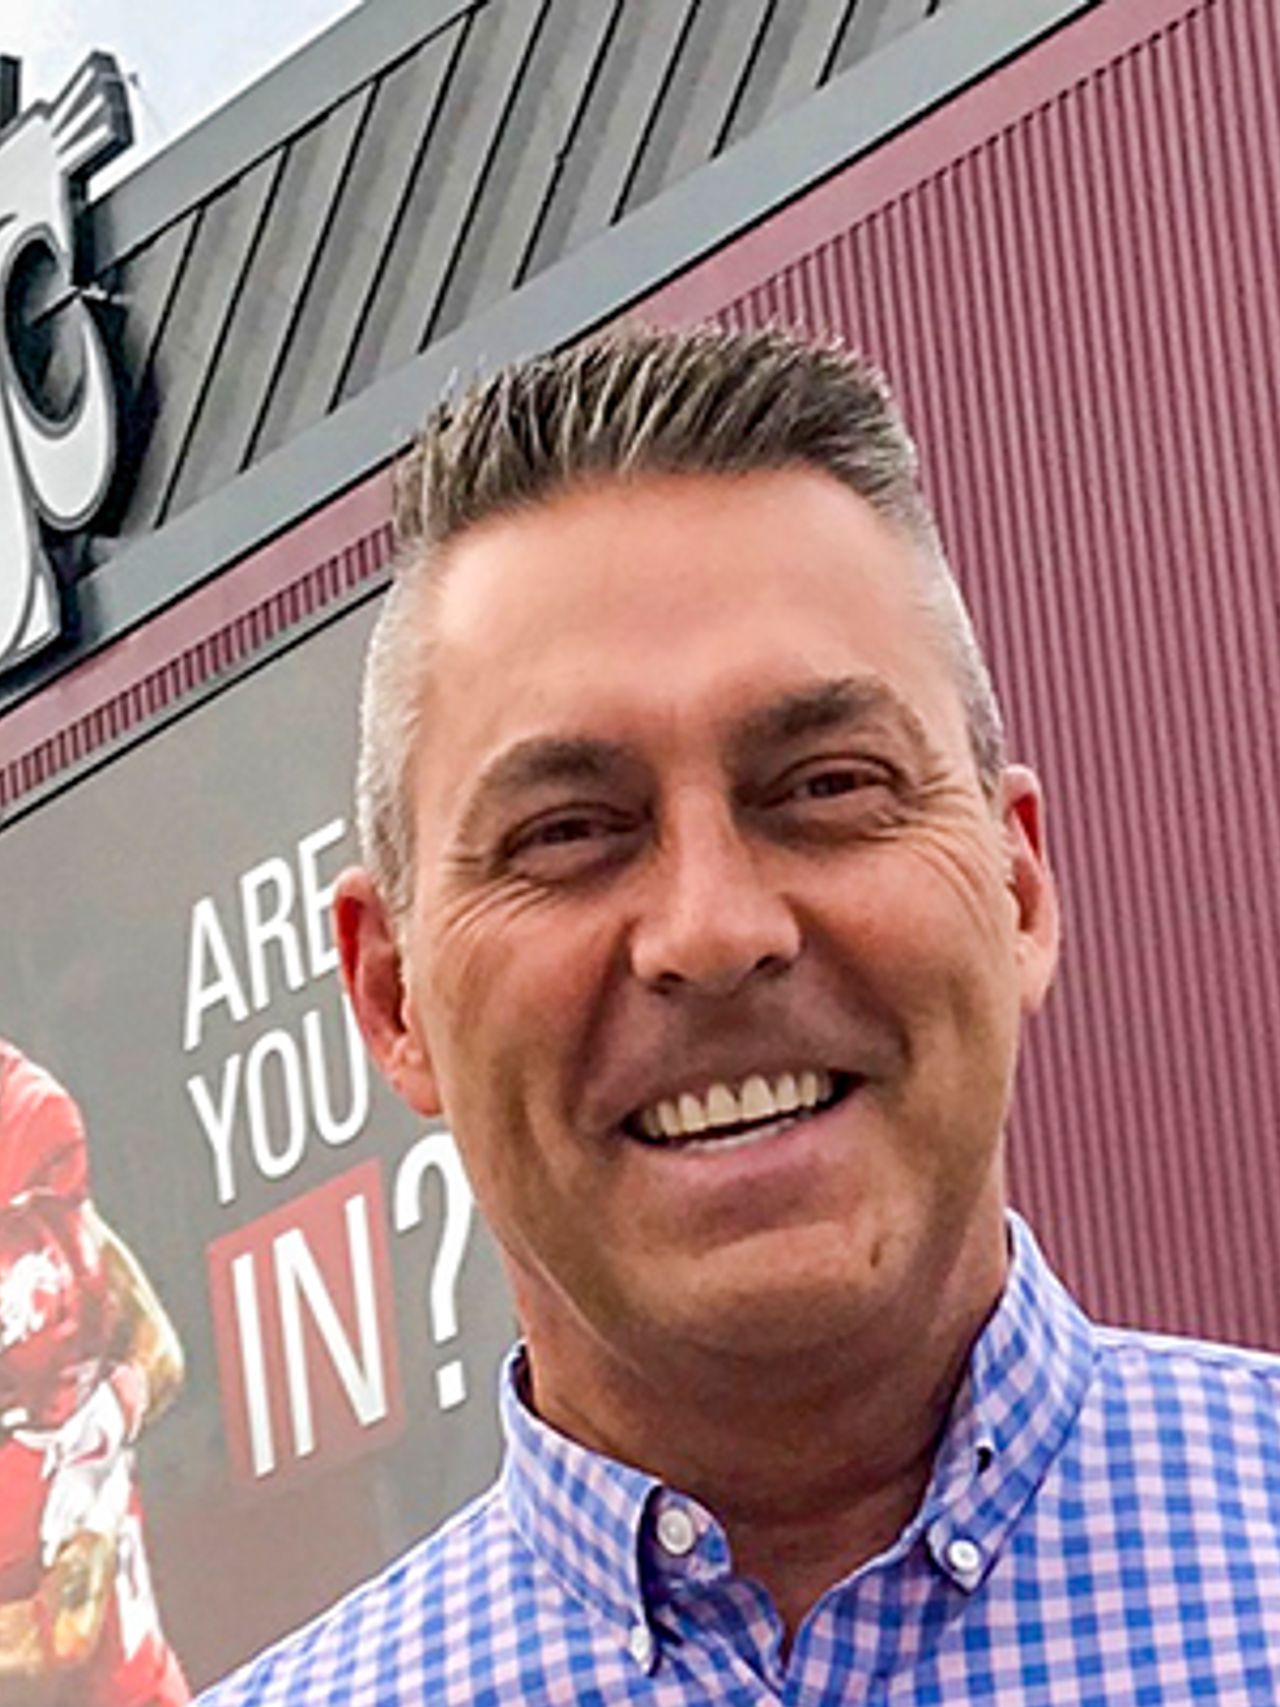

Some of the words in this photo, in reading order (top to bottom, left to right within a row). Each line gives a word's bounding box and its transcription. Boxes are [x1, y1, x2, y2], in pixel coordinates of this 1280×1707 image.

[183, 817, 348, 1052] ARE
[186, 992, 370, 1205] YOU
[230, 1132, 475, 1479] IN?
